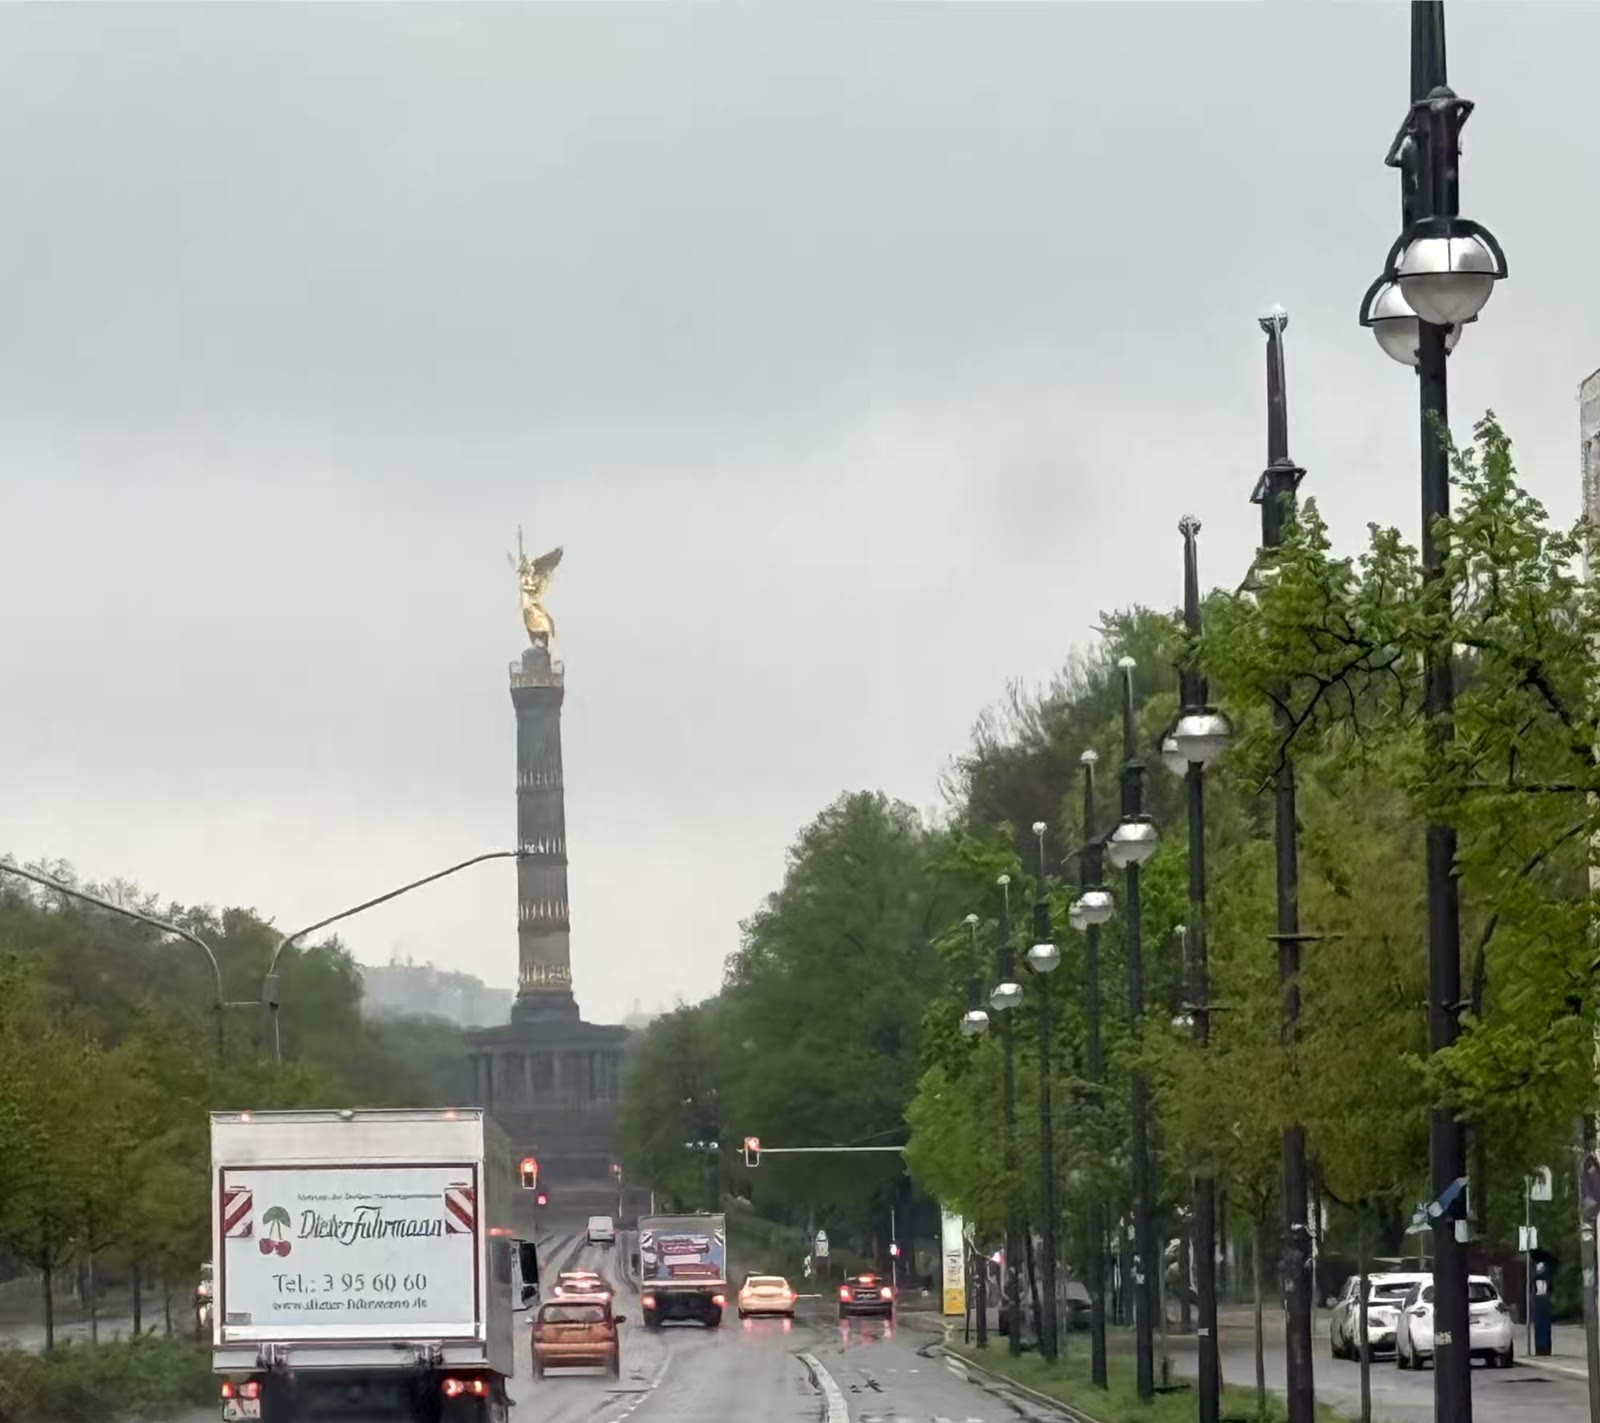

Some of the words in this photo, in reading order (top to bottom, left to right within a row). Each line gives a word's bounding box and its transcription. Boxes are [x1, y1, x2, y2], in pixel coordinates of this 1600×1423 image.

[322, 1274, 334, 1292] 3
[341, 1273, 365, 1292] 95
[372, 1273, 397, 1293] 60
[403, 1272, 427, 1292] 60
